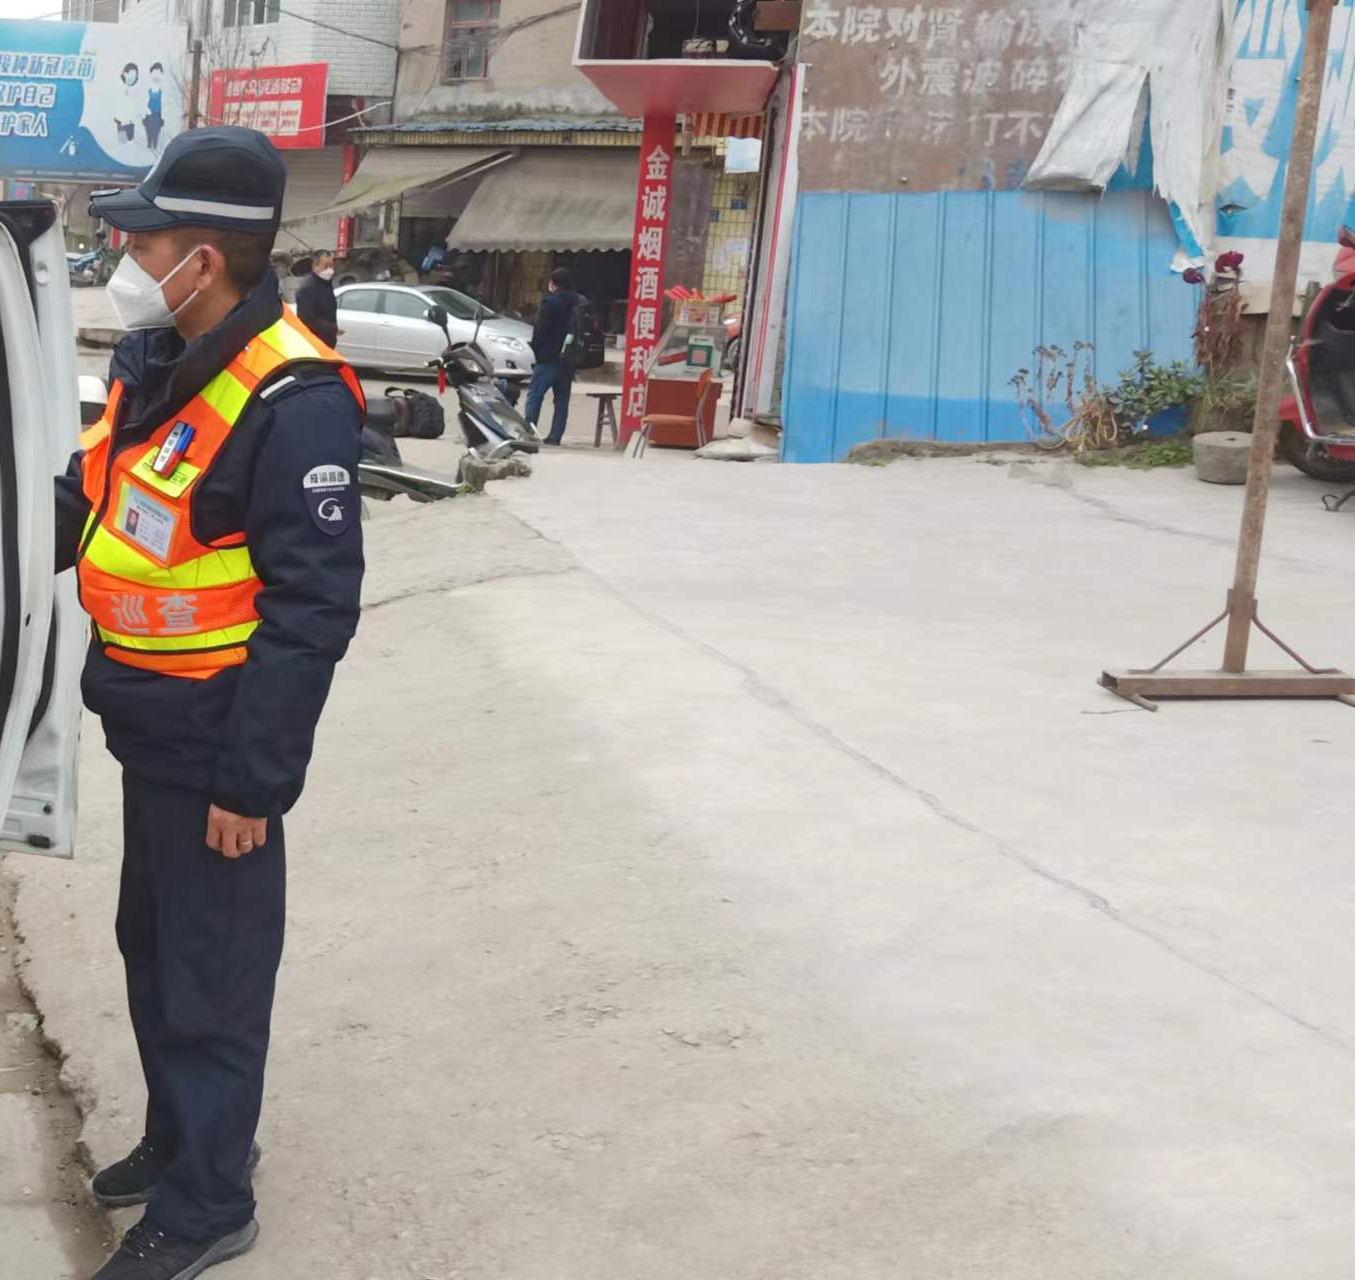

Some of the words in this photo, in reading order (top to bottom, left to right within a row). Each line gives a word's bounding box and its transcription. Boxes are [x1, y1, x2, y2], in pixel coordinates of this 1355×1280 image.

[625, 144, 670, 418] 金诚烟酒便利店
[110, 591, 201, 634] 巡查
